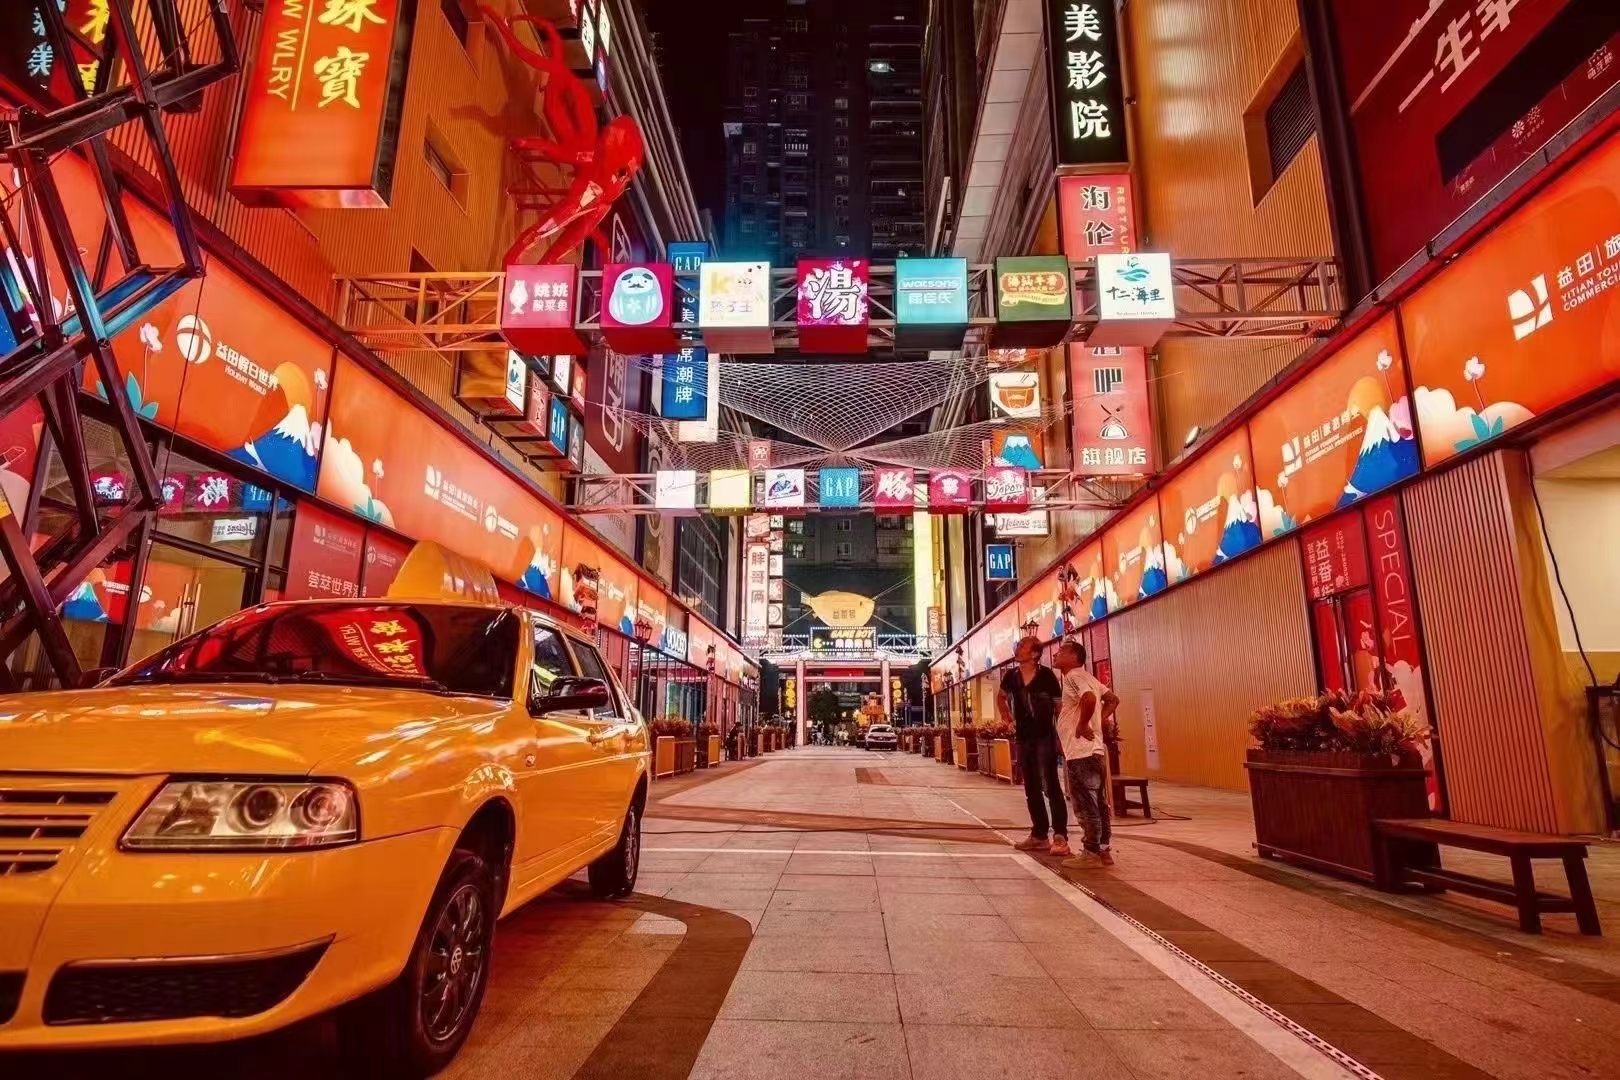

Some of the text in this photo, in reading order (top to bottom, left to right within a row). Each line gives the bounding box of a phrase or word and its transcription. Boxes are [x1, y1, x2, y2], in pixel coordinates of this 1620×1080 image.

[267, 28, 300, 100] WLRY
[1064, 3, 1111, 139] 美影院
[1561, 260, 1620, 302] YITIAN TOU
[1563, 273, 1620, 312] COMMERCI
[551, 408, 565, 441] GAP
[1081, 446, 1147, 465] 旗舰店
[825, 477, 853, 497] GAP
[990, 553, 1011, 569] GAP
[1374, 509, 1412, 656] SPECIAL
